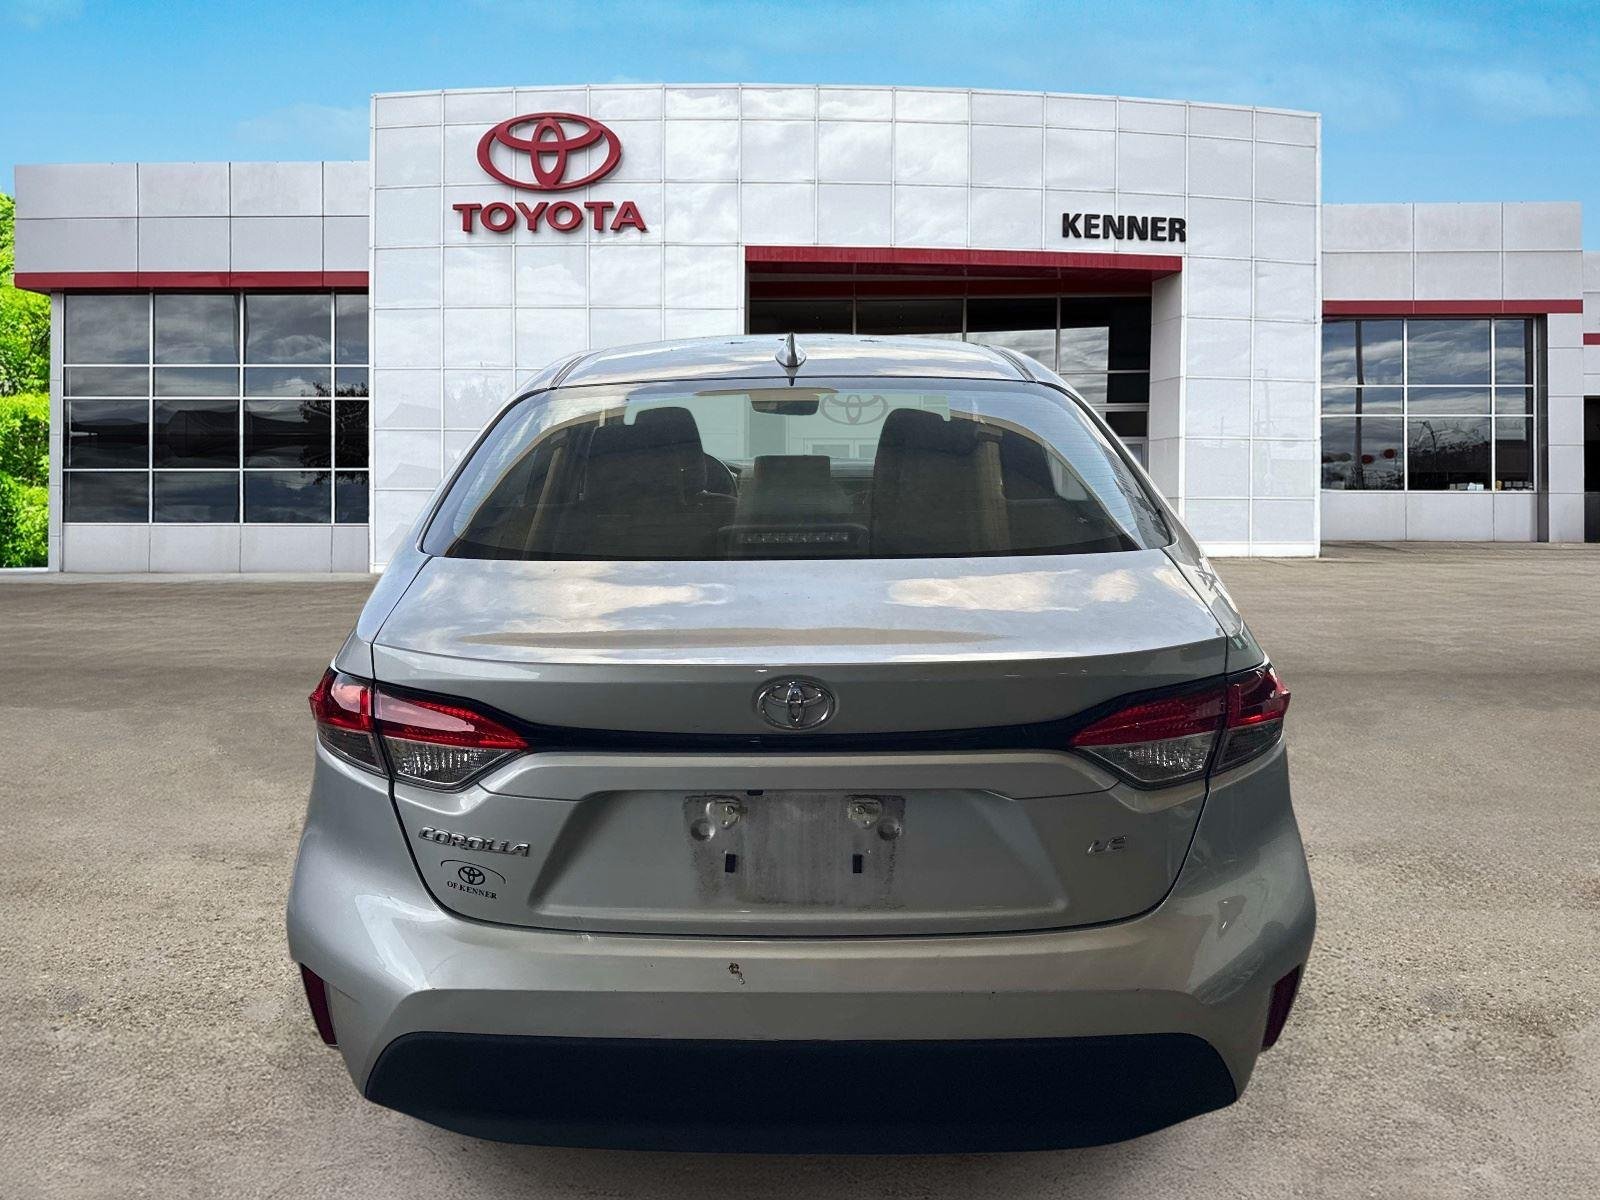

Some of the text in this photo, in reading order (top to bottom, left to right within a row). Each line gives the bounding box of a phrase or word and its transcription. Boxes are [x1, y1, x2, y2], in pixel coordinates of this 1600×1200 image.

[452, 201, 647, 232] TOYOTA
[1062, 213, 1186, 242] KENNER
[419, 826, 530, 857] COROLLA
[1087, 835, 1126, 855] LE
[447, 880, 497, 900] OF KENNER
